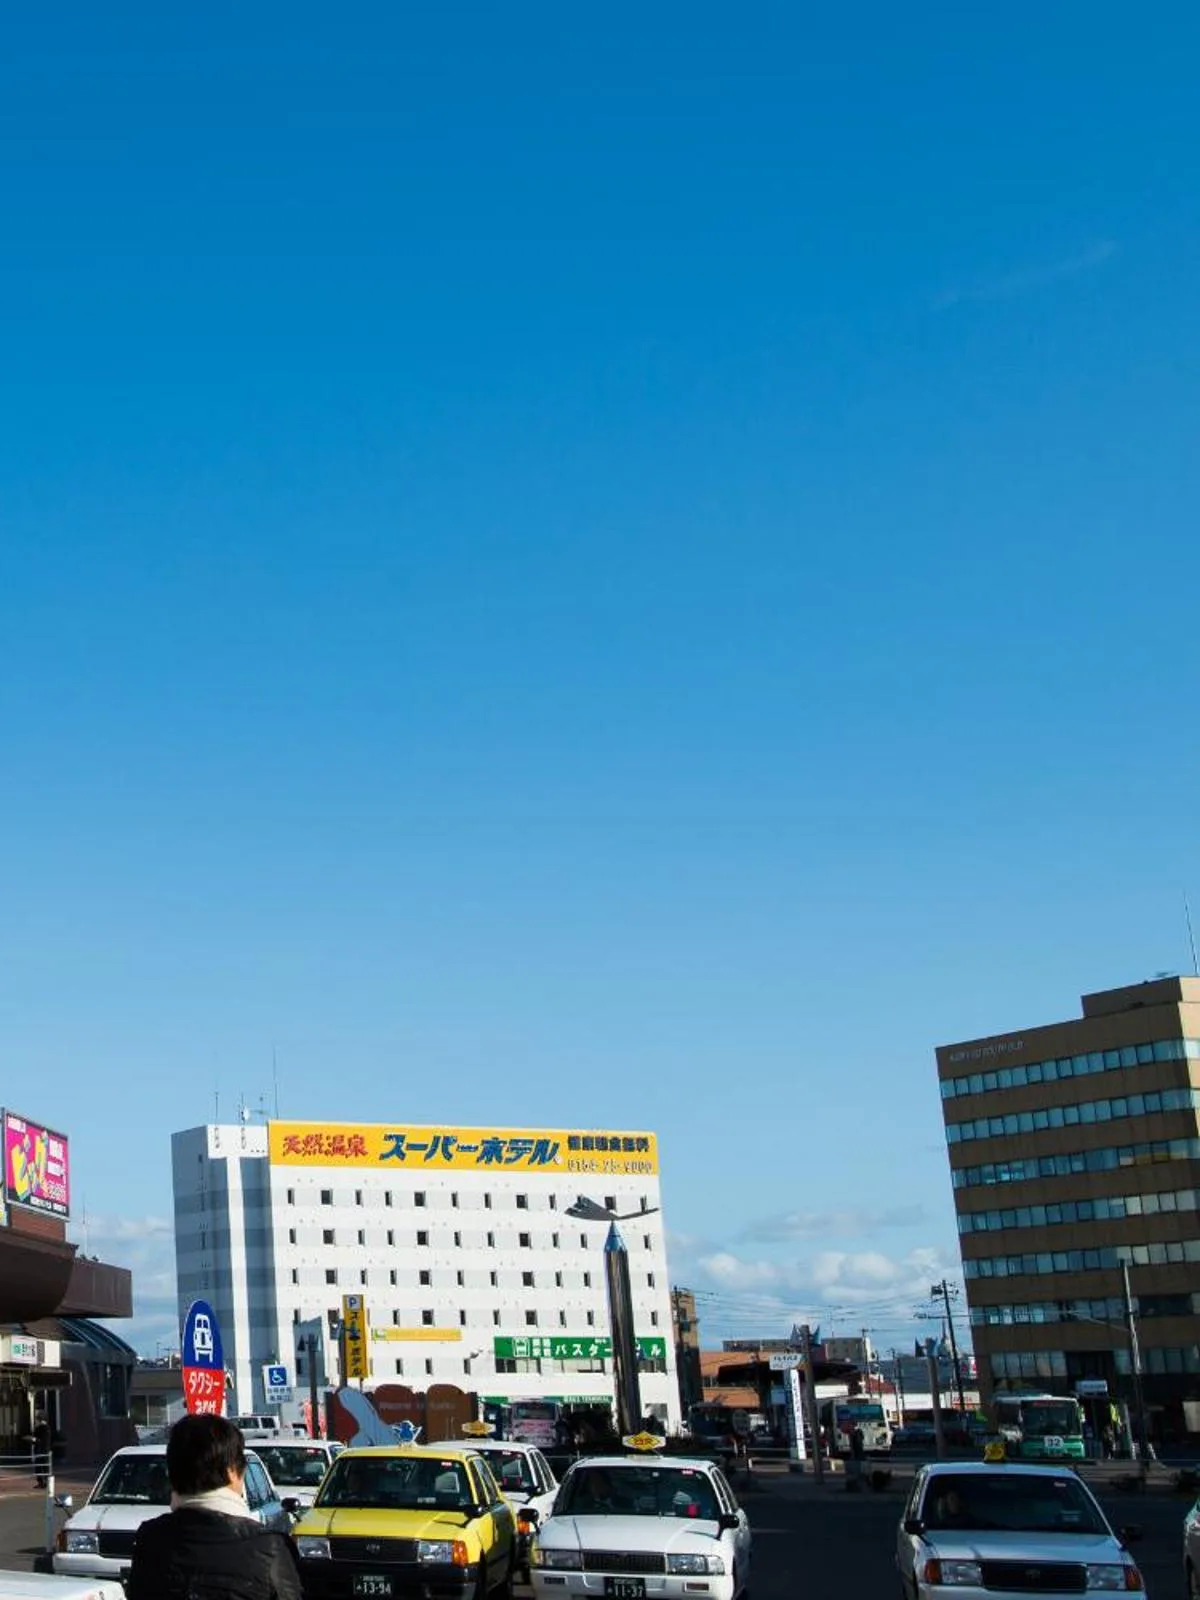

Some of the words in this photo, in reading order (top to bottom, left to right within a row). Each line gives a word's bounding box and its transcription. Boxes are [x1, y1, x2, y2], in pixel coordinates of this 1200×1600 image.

[282, 1133, 369, 1159] 天然温泉
[379, 1133, 560, 1166] スーパーホテル
[188, 1370, 221, 1395] タクシー
